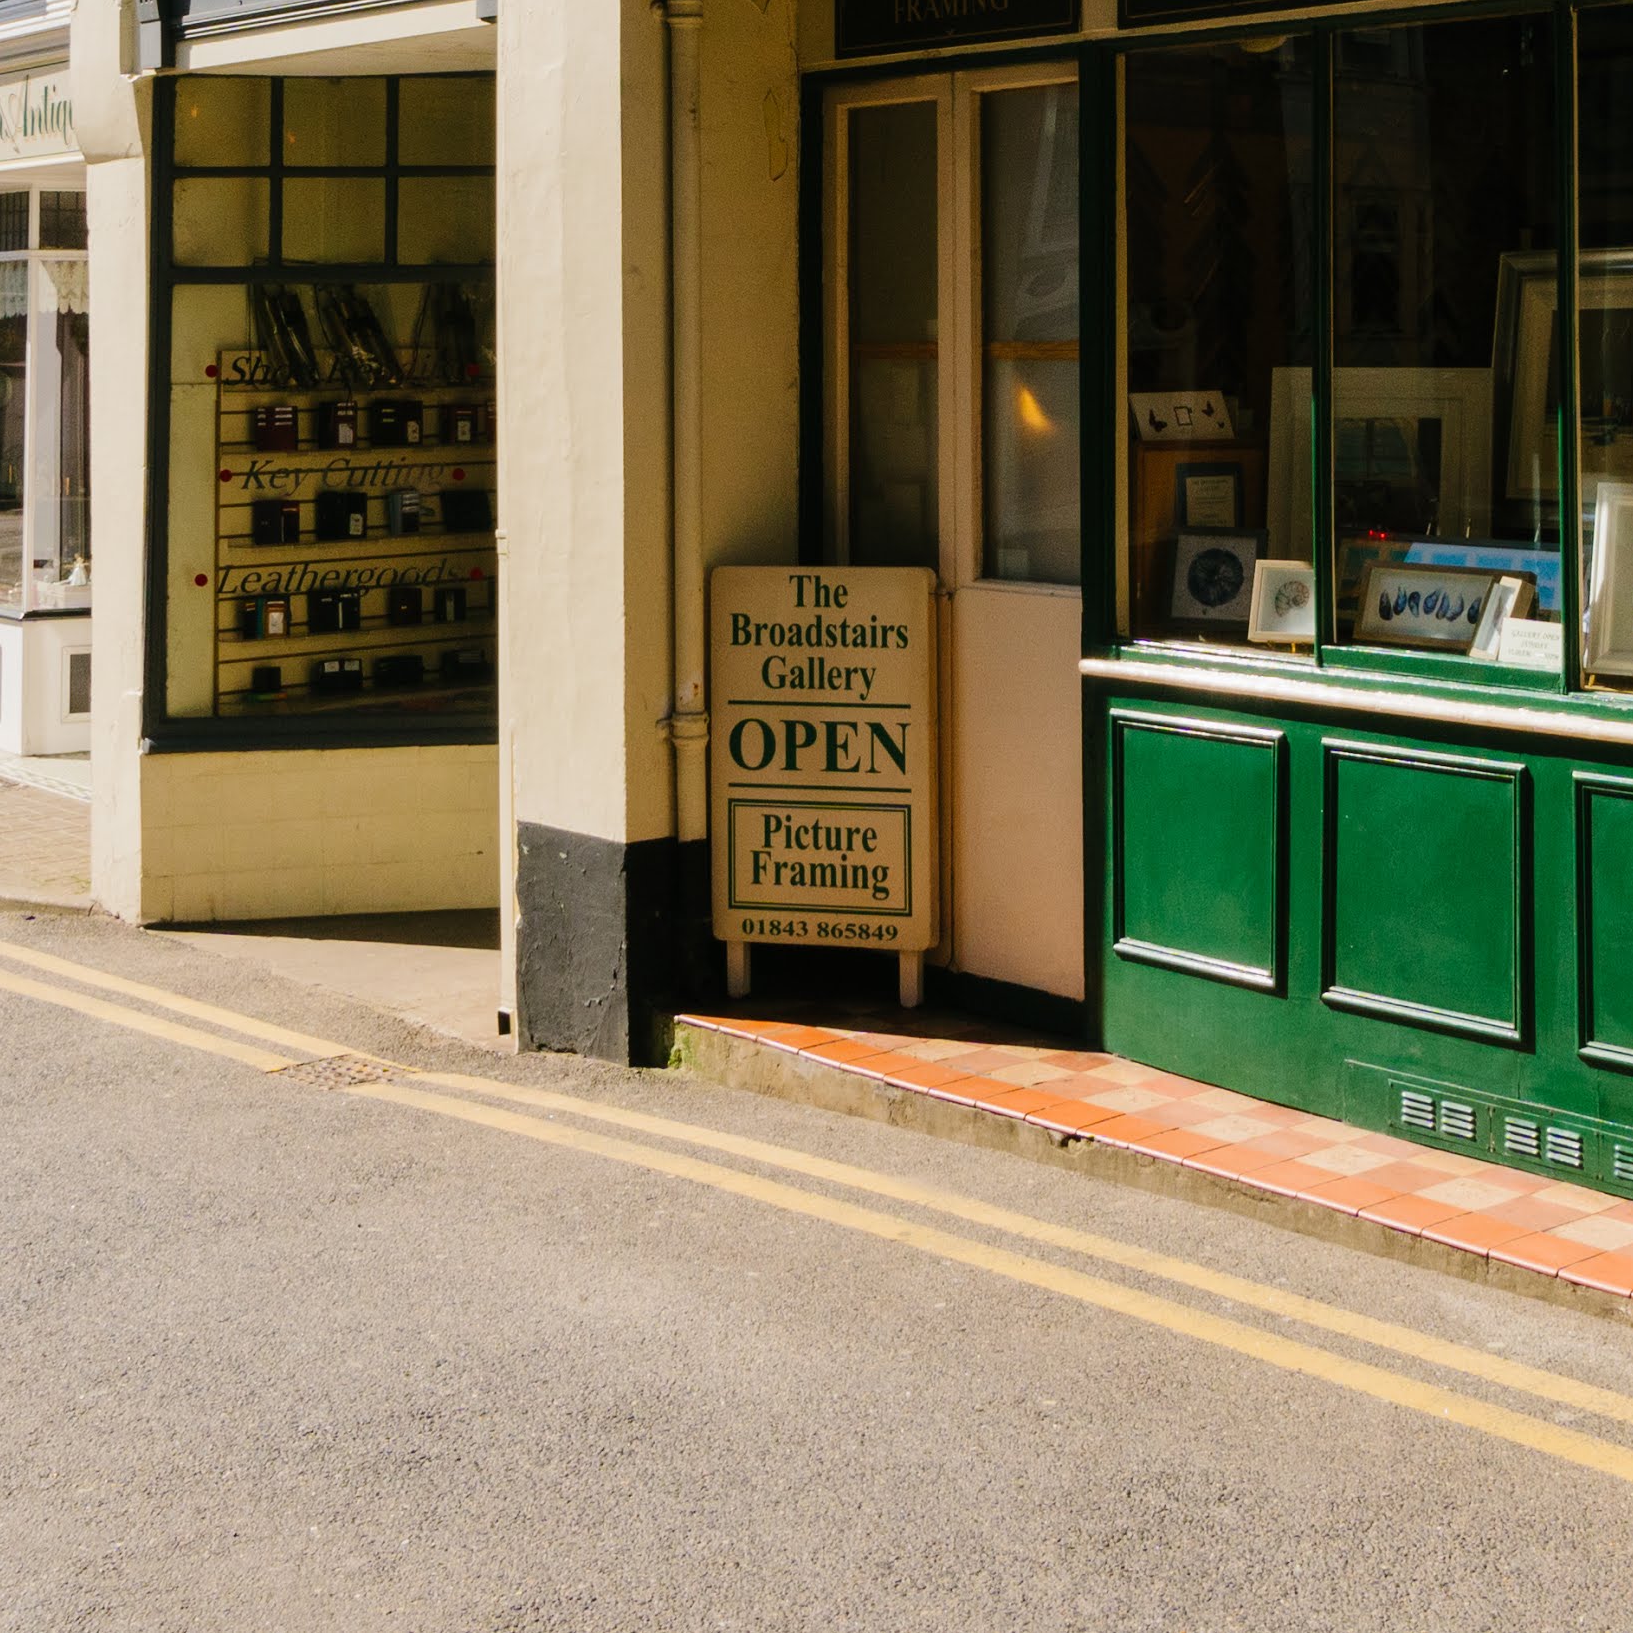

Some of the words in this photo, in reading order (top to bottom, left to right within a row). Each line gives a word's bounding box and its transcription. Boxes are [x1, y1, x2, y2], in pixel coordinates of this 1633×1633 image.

[241, 459, 311, 497] Key
[320, 456, 446, 494] Cutting
[217, 558, 461, 596] Leathergoods
[789, 574, 848, 608] The
[730, 613, 909, 649] Broadstairs
[761, 655, 876, 700] Gallery
[728, 718, 911, 776] OPEN
[762, 814, 877, 852] Picture
[751, 850, 890, 900] Framing
[742, 918, 809, 938] 01843
[817, 921, 898, 942] 865849
